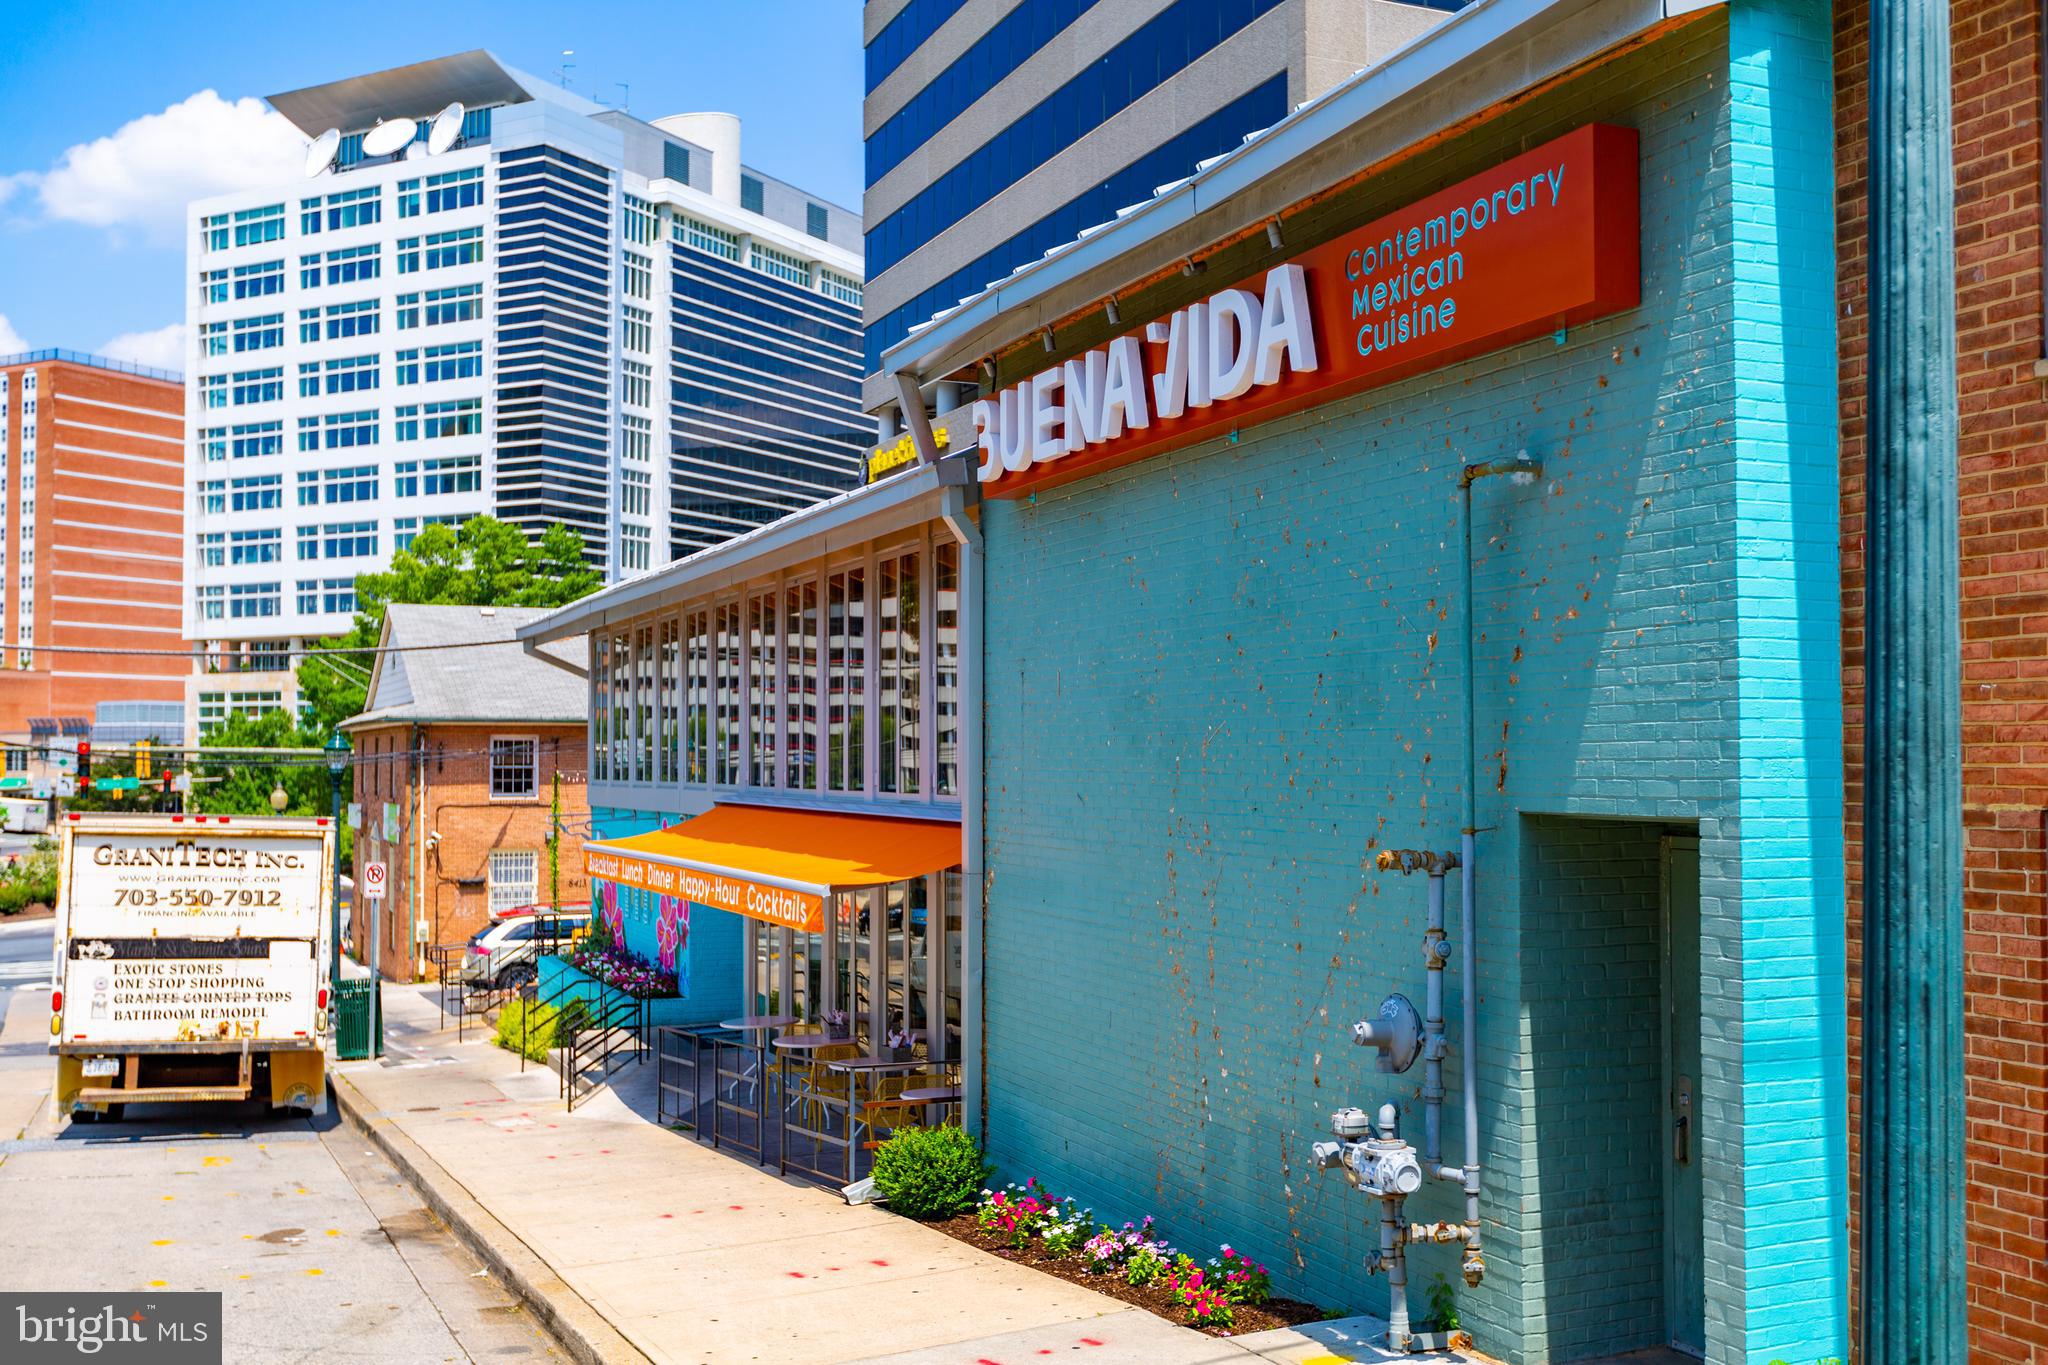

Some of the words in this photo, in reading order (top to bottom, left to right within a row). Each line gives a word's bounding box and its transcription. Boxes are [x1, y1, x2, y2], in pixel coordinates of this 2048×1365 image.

[1345, 163, 1564, 281] Contemporary
[1352, 251, 1463, 320] Mexican
[1357, 298, 1456, 356] Cuisine
[973, 336, 1149, 482] BUENA
[1146, 264, 1317, 418] VIDA
[114, 889, 281, 906] 703-550-7912
[588, 853, 618, 877] Breakfast
[622, 858, 643, 883] Lunch
[647, 863, 674, 889] Dinner
[680, 869, 740, 905] Happy-Hour
[747, 884, 807, 924] Cocktails
[114, 964, 165, 975] EXOTIC
[170, 963, 223, 975] STONES
[114, 978, 142, 989] ONE
[148, 978, 185, 989] STOP
[190, 977, 264, 989] SHOPPING
[114, 993, 179, 1004] GRANITE
[256, 991, 292, 1003] TOPS
[114, 1008, 195, 1020] BATHROOM
[201, 1007, 269, 1019] REMODEL
